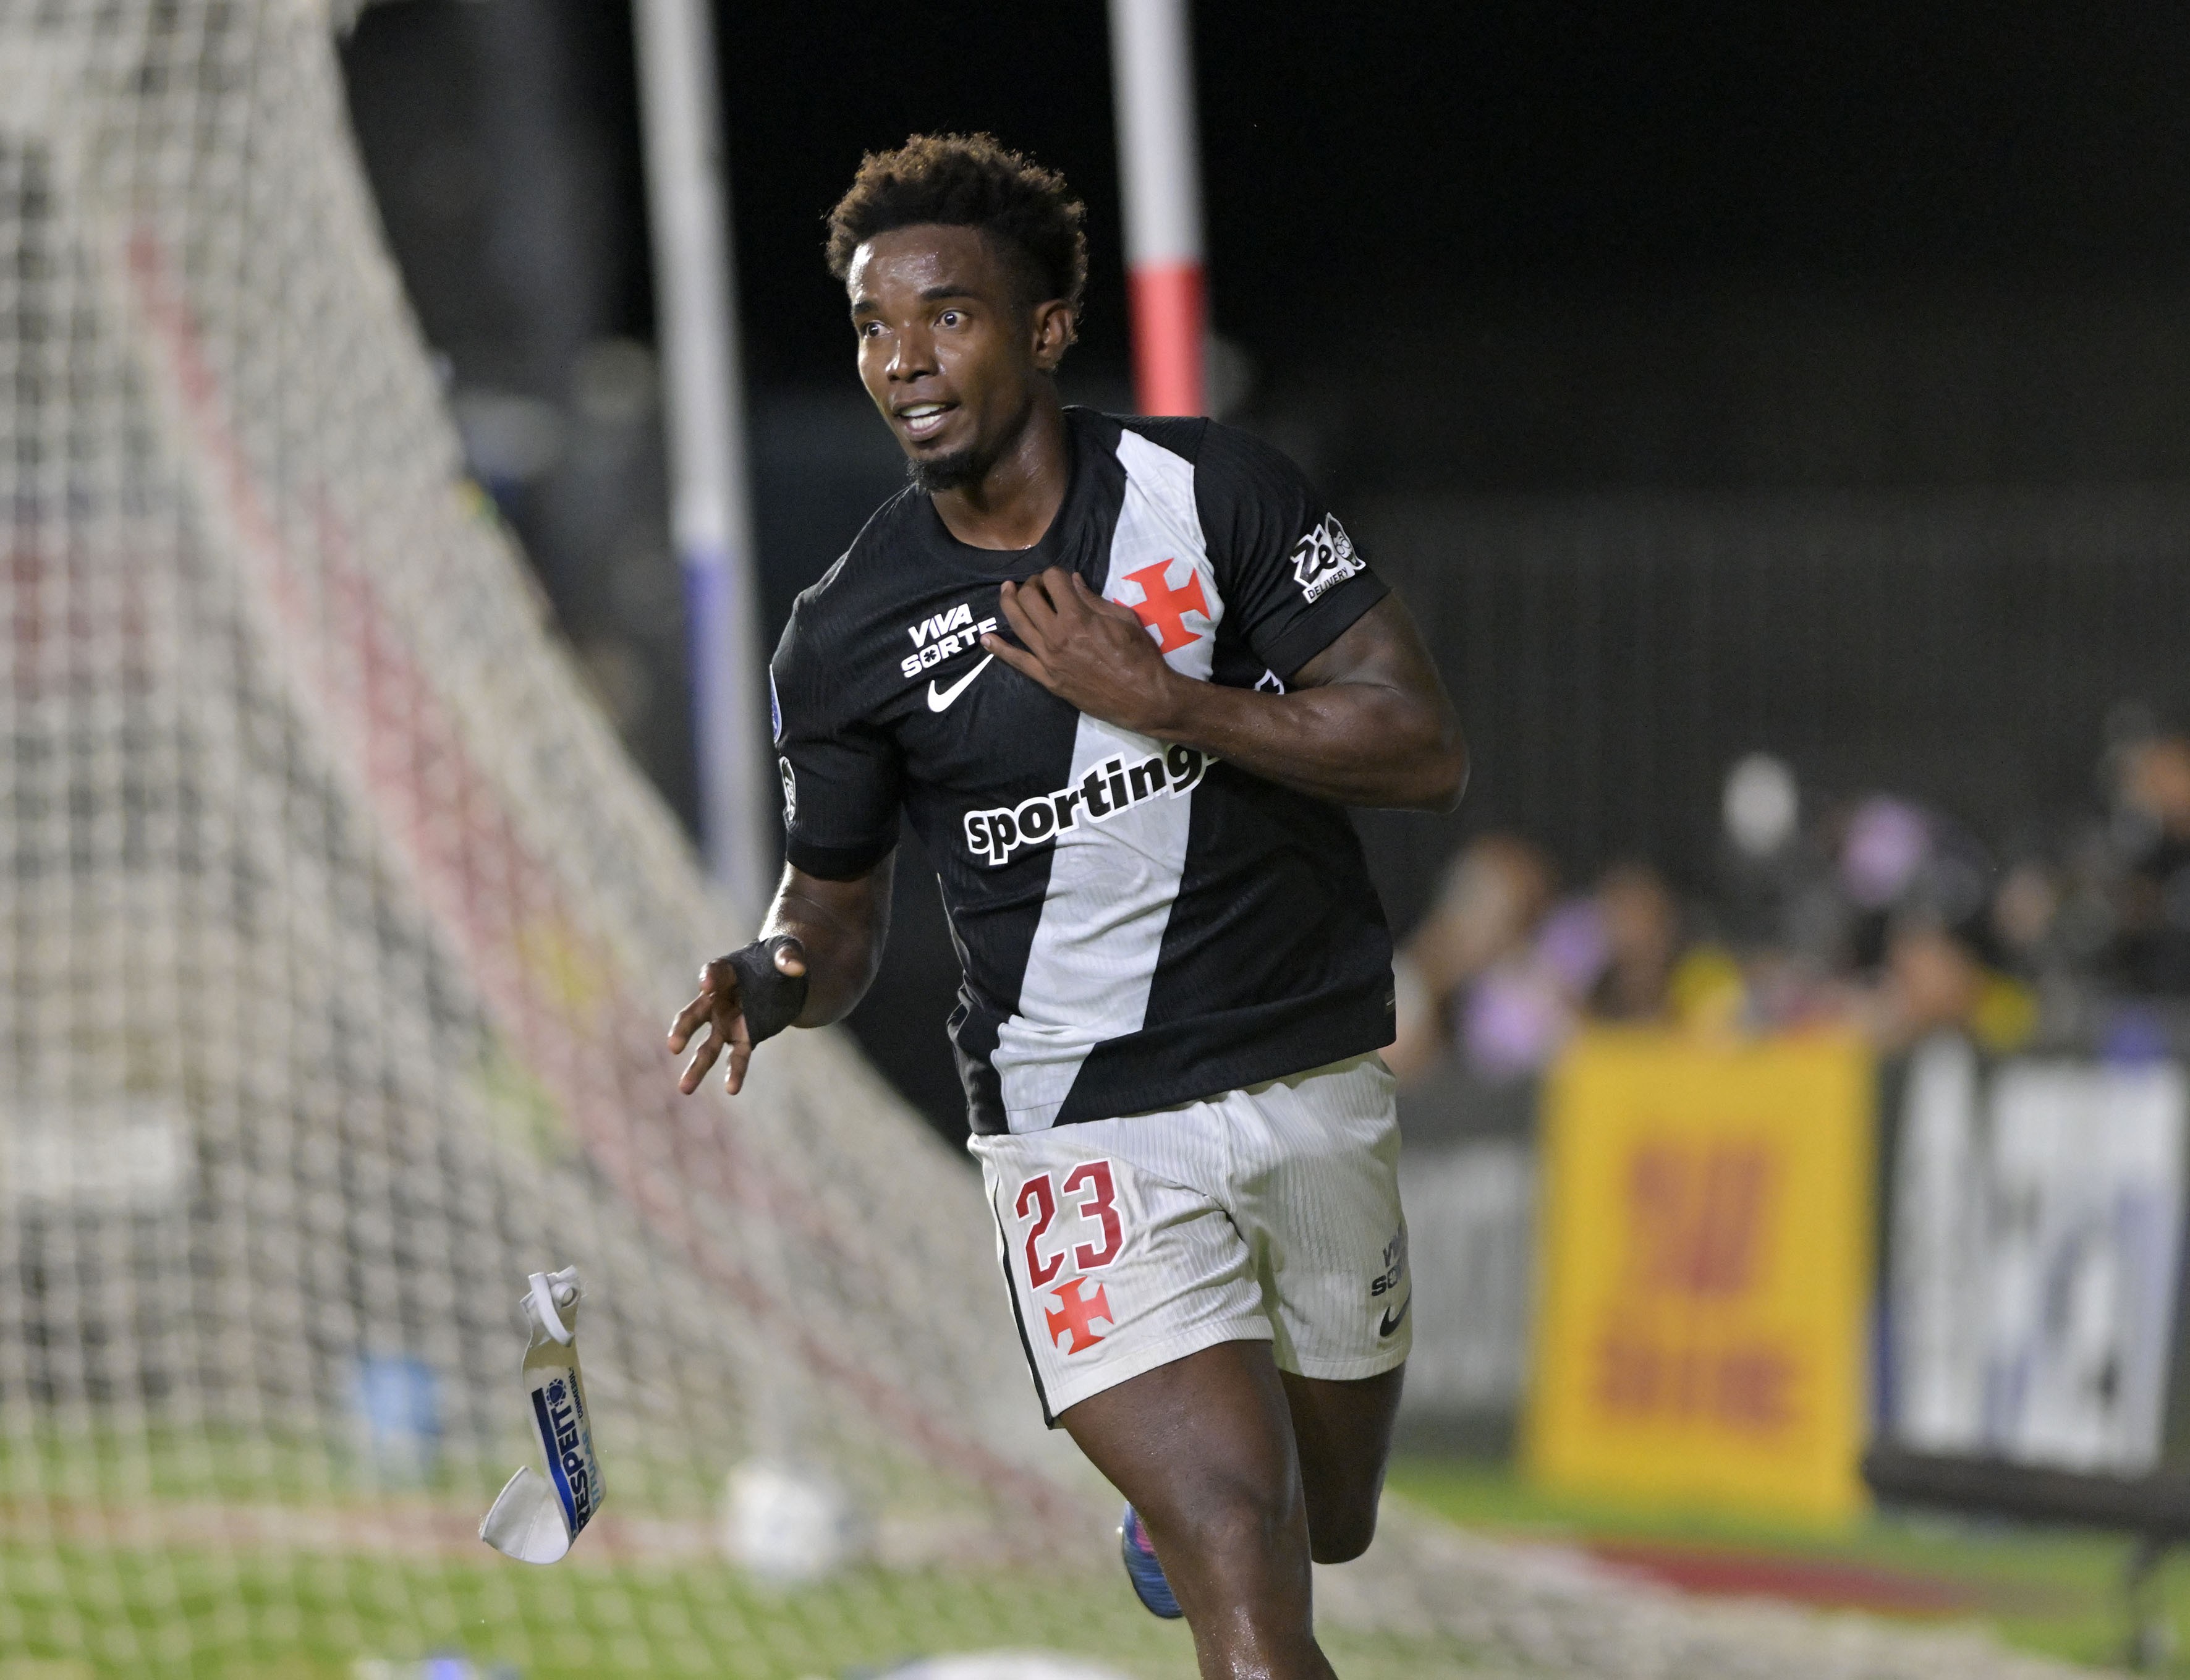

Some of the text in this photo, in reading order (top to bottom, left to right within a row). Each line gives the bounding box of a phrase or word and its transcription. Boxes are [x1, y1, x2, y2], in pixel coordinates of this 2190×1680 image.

[1307, 567, 1349, 600] DELIVERY
[900, 617, 998, 678] SORTE
[907, 603, 974, 648] VIVA
[1014, 1156, 1127, 1293] 23
